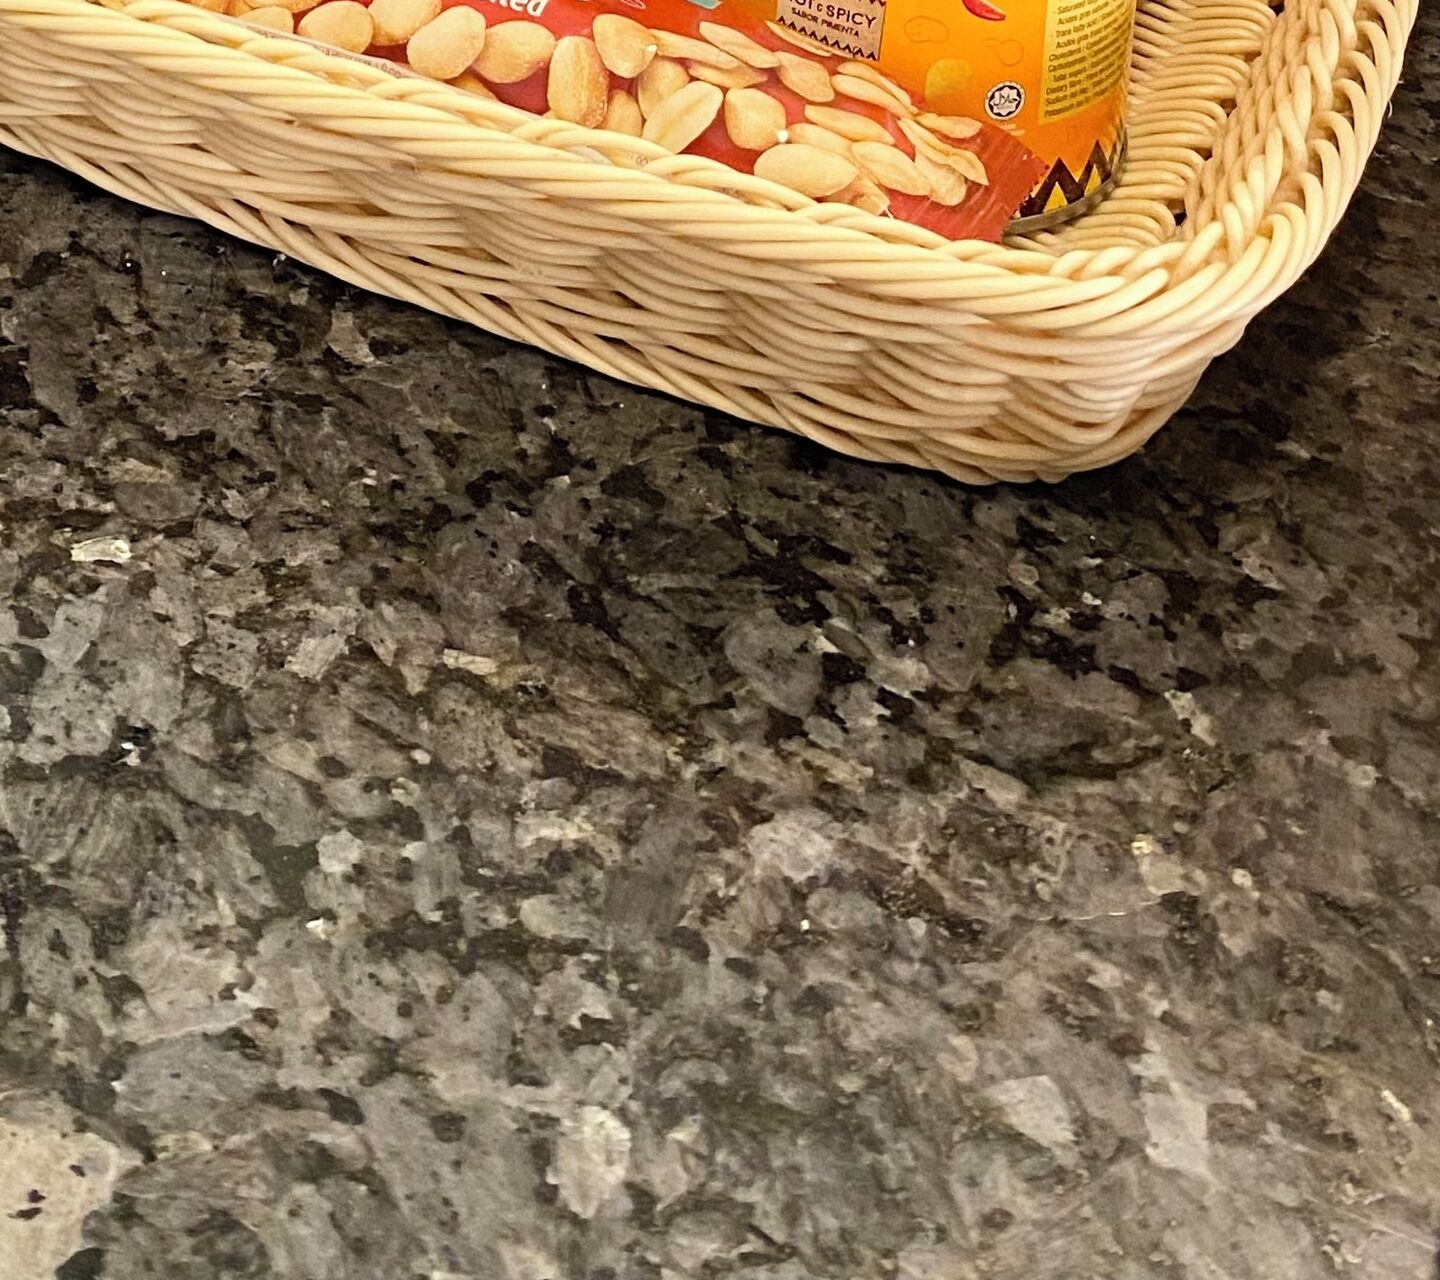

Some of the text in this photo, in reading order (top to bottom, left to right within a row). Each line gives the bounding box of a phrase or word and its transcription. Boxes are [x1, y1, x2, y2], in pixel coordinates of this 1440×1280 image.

[791, 7, 860, 38] SABOR PIMENTA
[826, 4, 877, 29] SPICY
